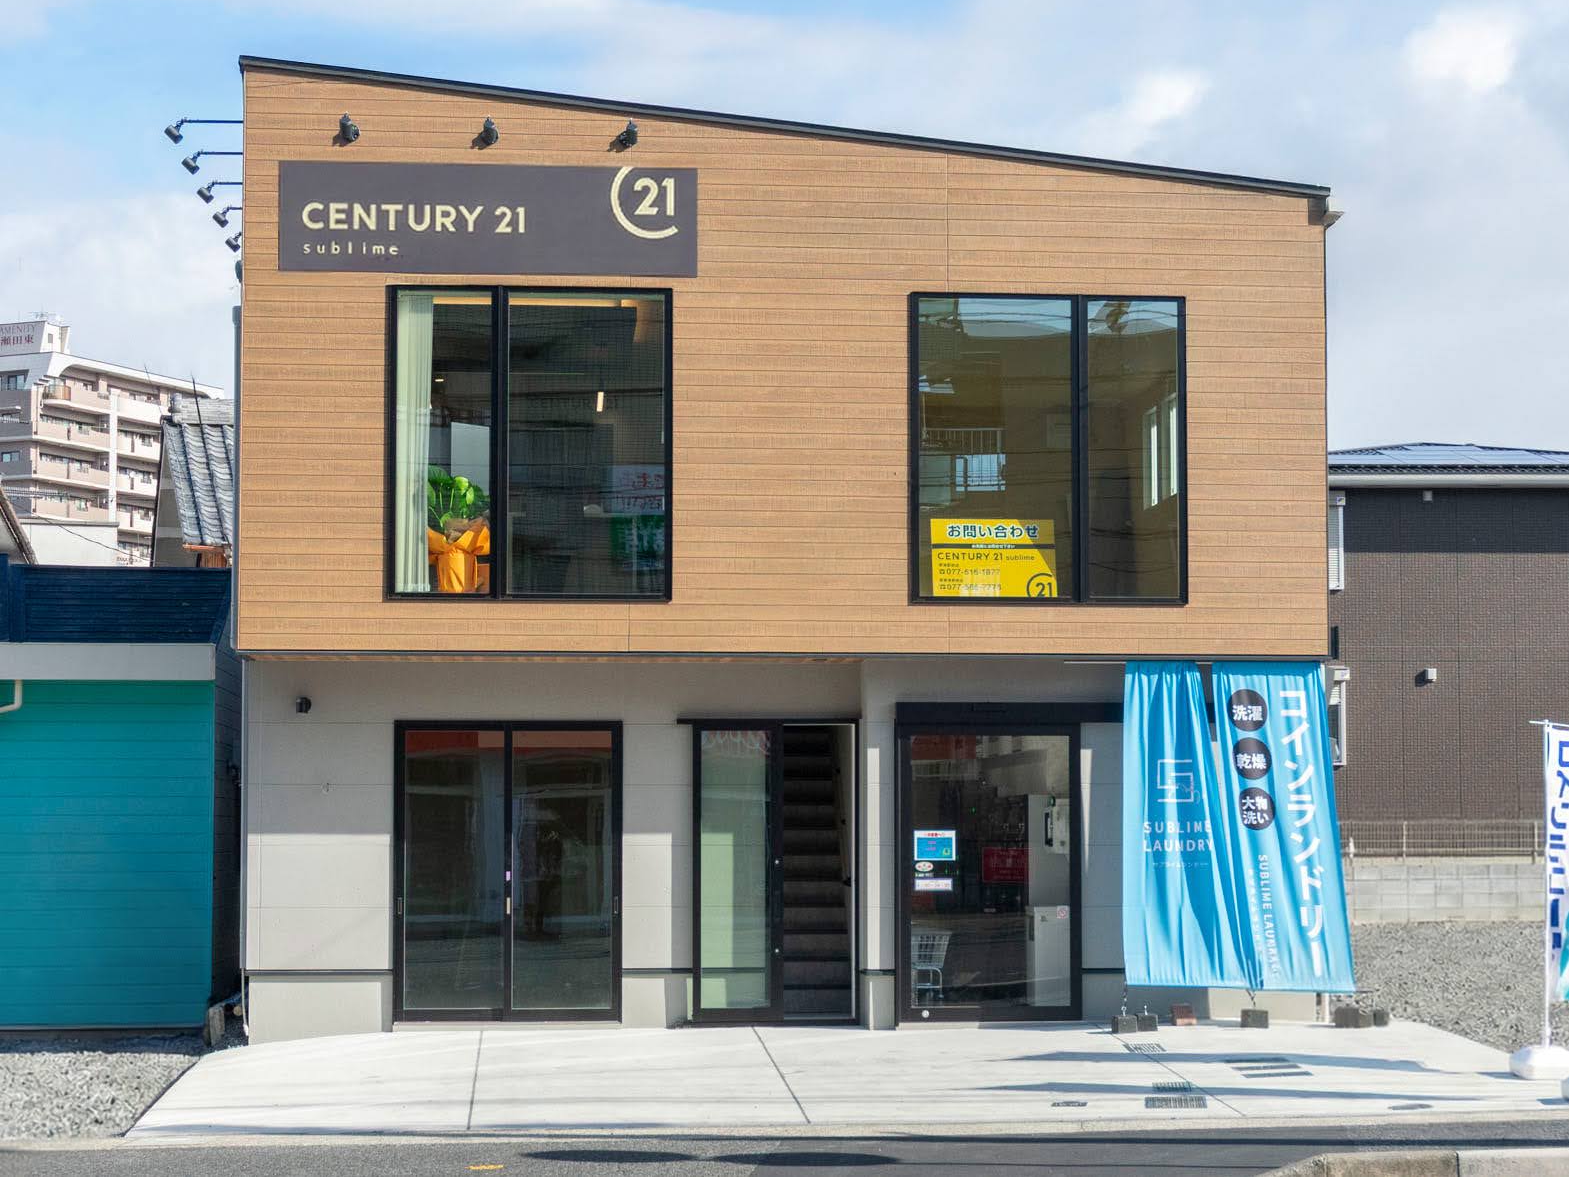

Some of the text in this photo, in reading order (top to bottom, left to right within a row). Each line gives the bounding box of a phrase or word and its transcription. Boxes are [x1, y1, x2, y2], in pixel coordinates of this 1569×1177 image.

[302, 201, 526, 234] CENTURY 21
[303, 240, 399, 256] sublime
[947, 525, 1039, 539] お問い合わせ
[937, 552, 990, 561] CENTURY
[993, 553, 1003, 561] 21
[1232, 704, 1263, 721] 洗濯
[1236, 753, 1267, 769] 乾燥
[1242, 796, 1268, 810] 大物
[1243, 811, 1269, 825] 洗い
[1143, 820, 1212, 833] SUBLIME
[1279, 690, 1325, 977] コインランドリー
[1142, 839, 1214, 852] LAUNDRY
[1258, 854, 1273, 910] SUBLIME
